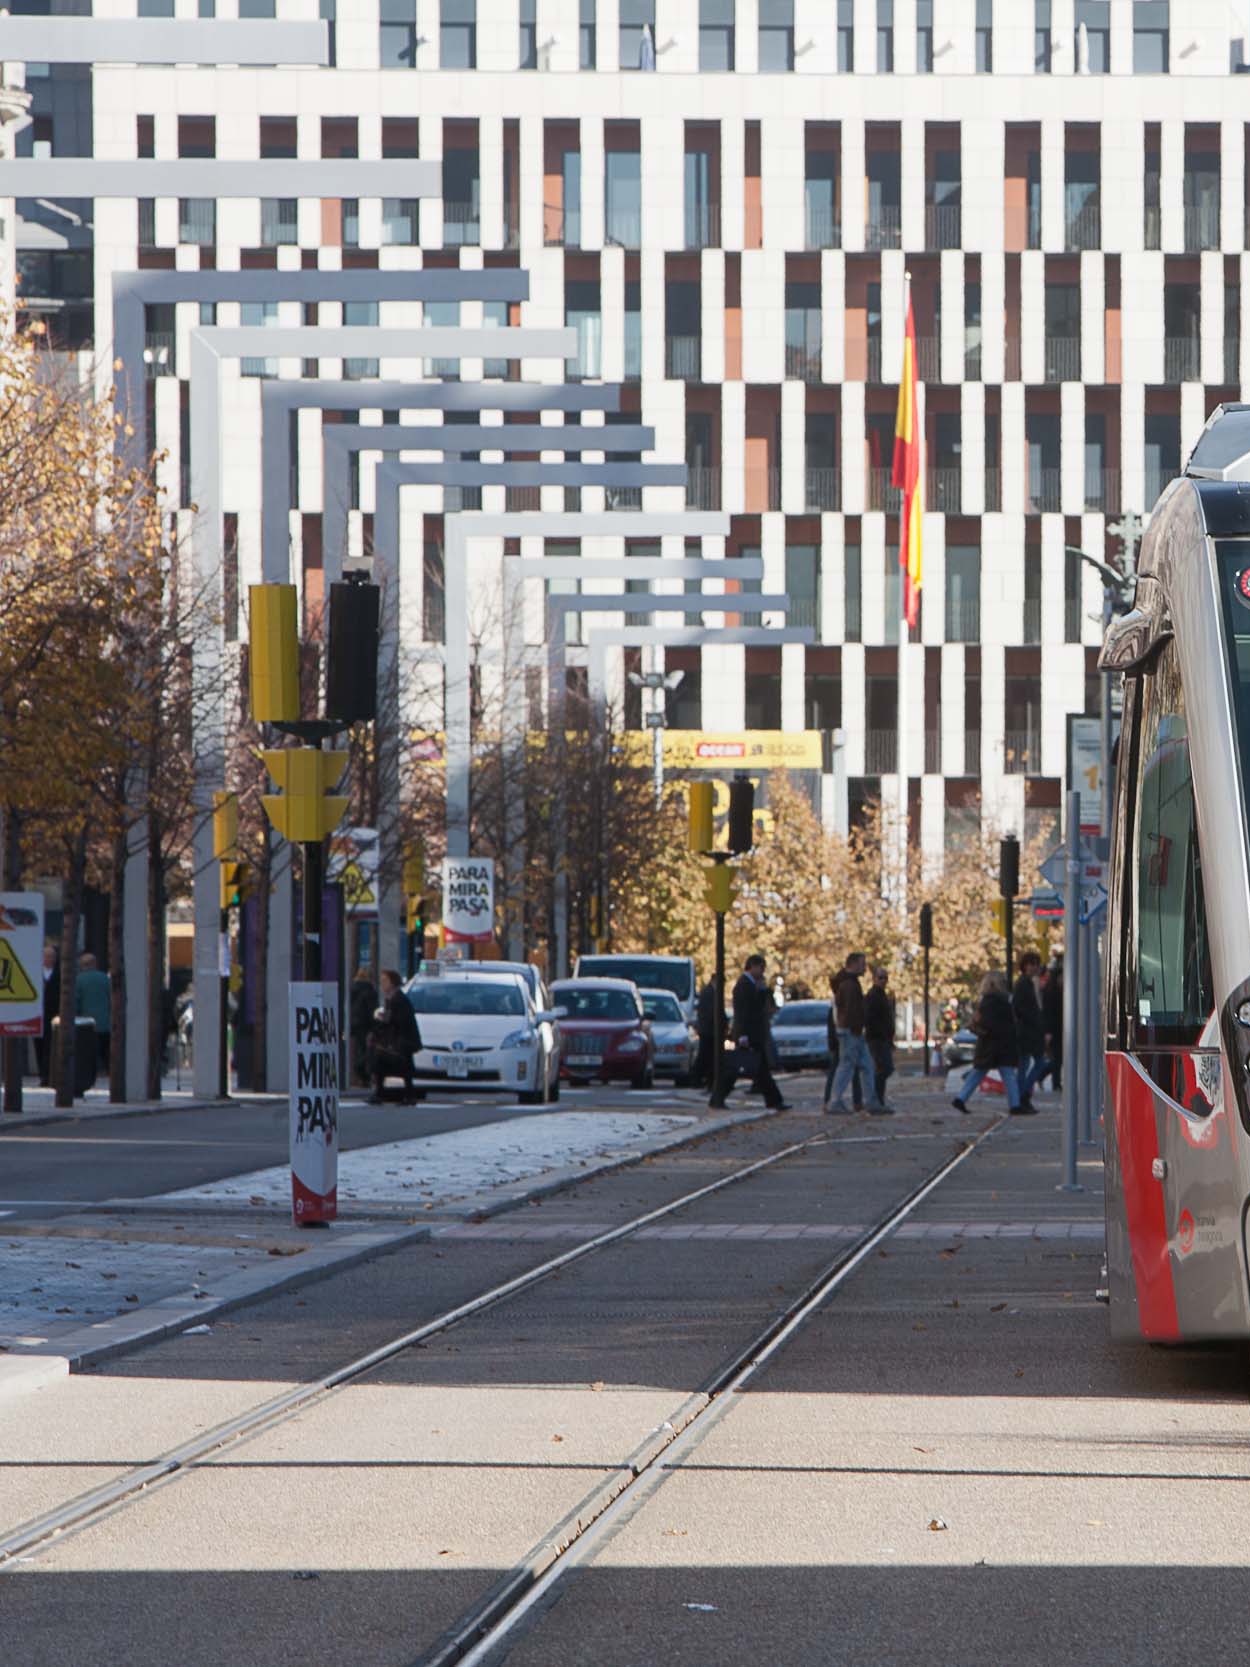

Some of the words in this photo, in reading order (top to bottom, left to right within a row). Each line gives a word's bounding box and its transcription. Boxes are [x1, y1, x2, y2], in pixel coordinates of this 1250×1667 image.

[448, 867, 489, 880] PARA
[448, 883, 489, 897] MIRA
[448, 898, 489, 913] PASA
[295, 1007, 337, 1044] PARA
[297, 1052, 337, 1089] MIRA
[297, 1096, 337, 1135] PASA
